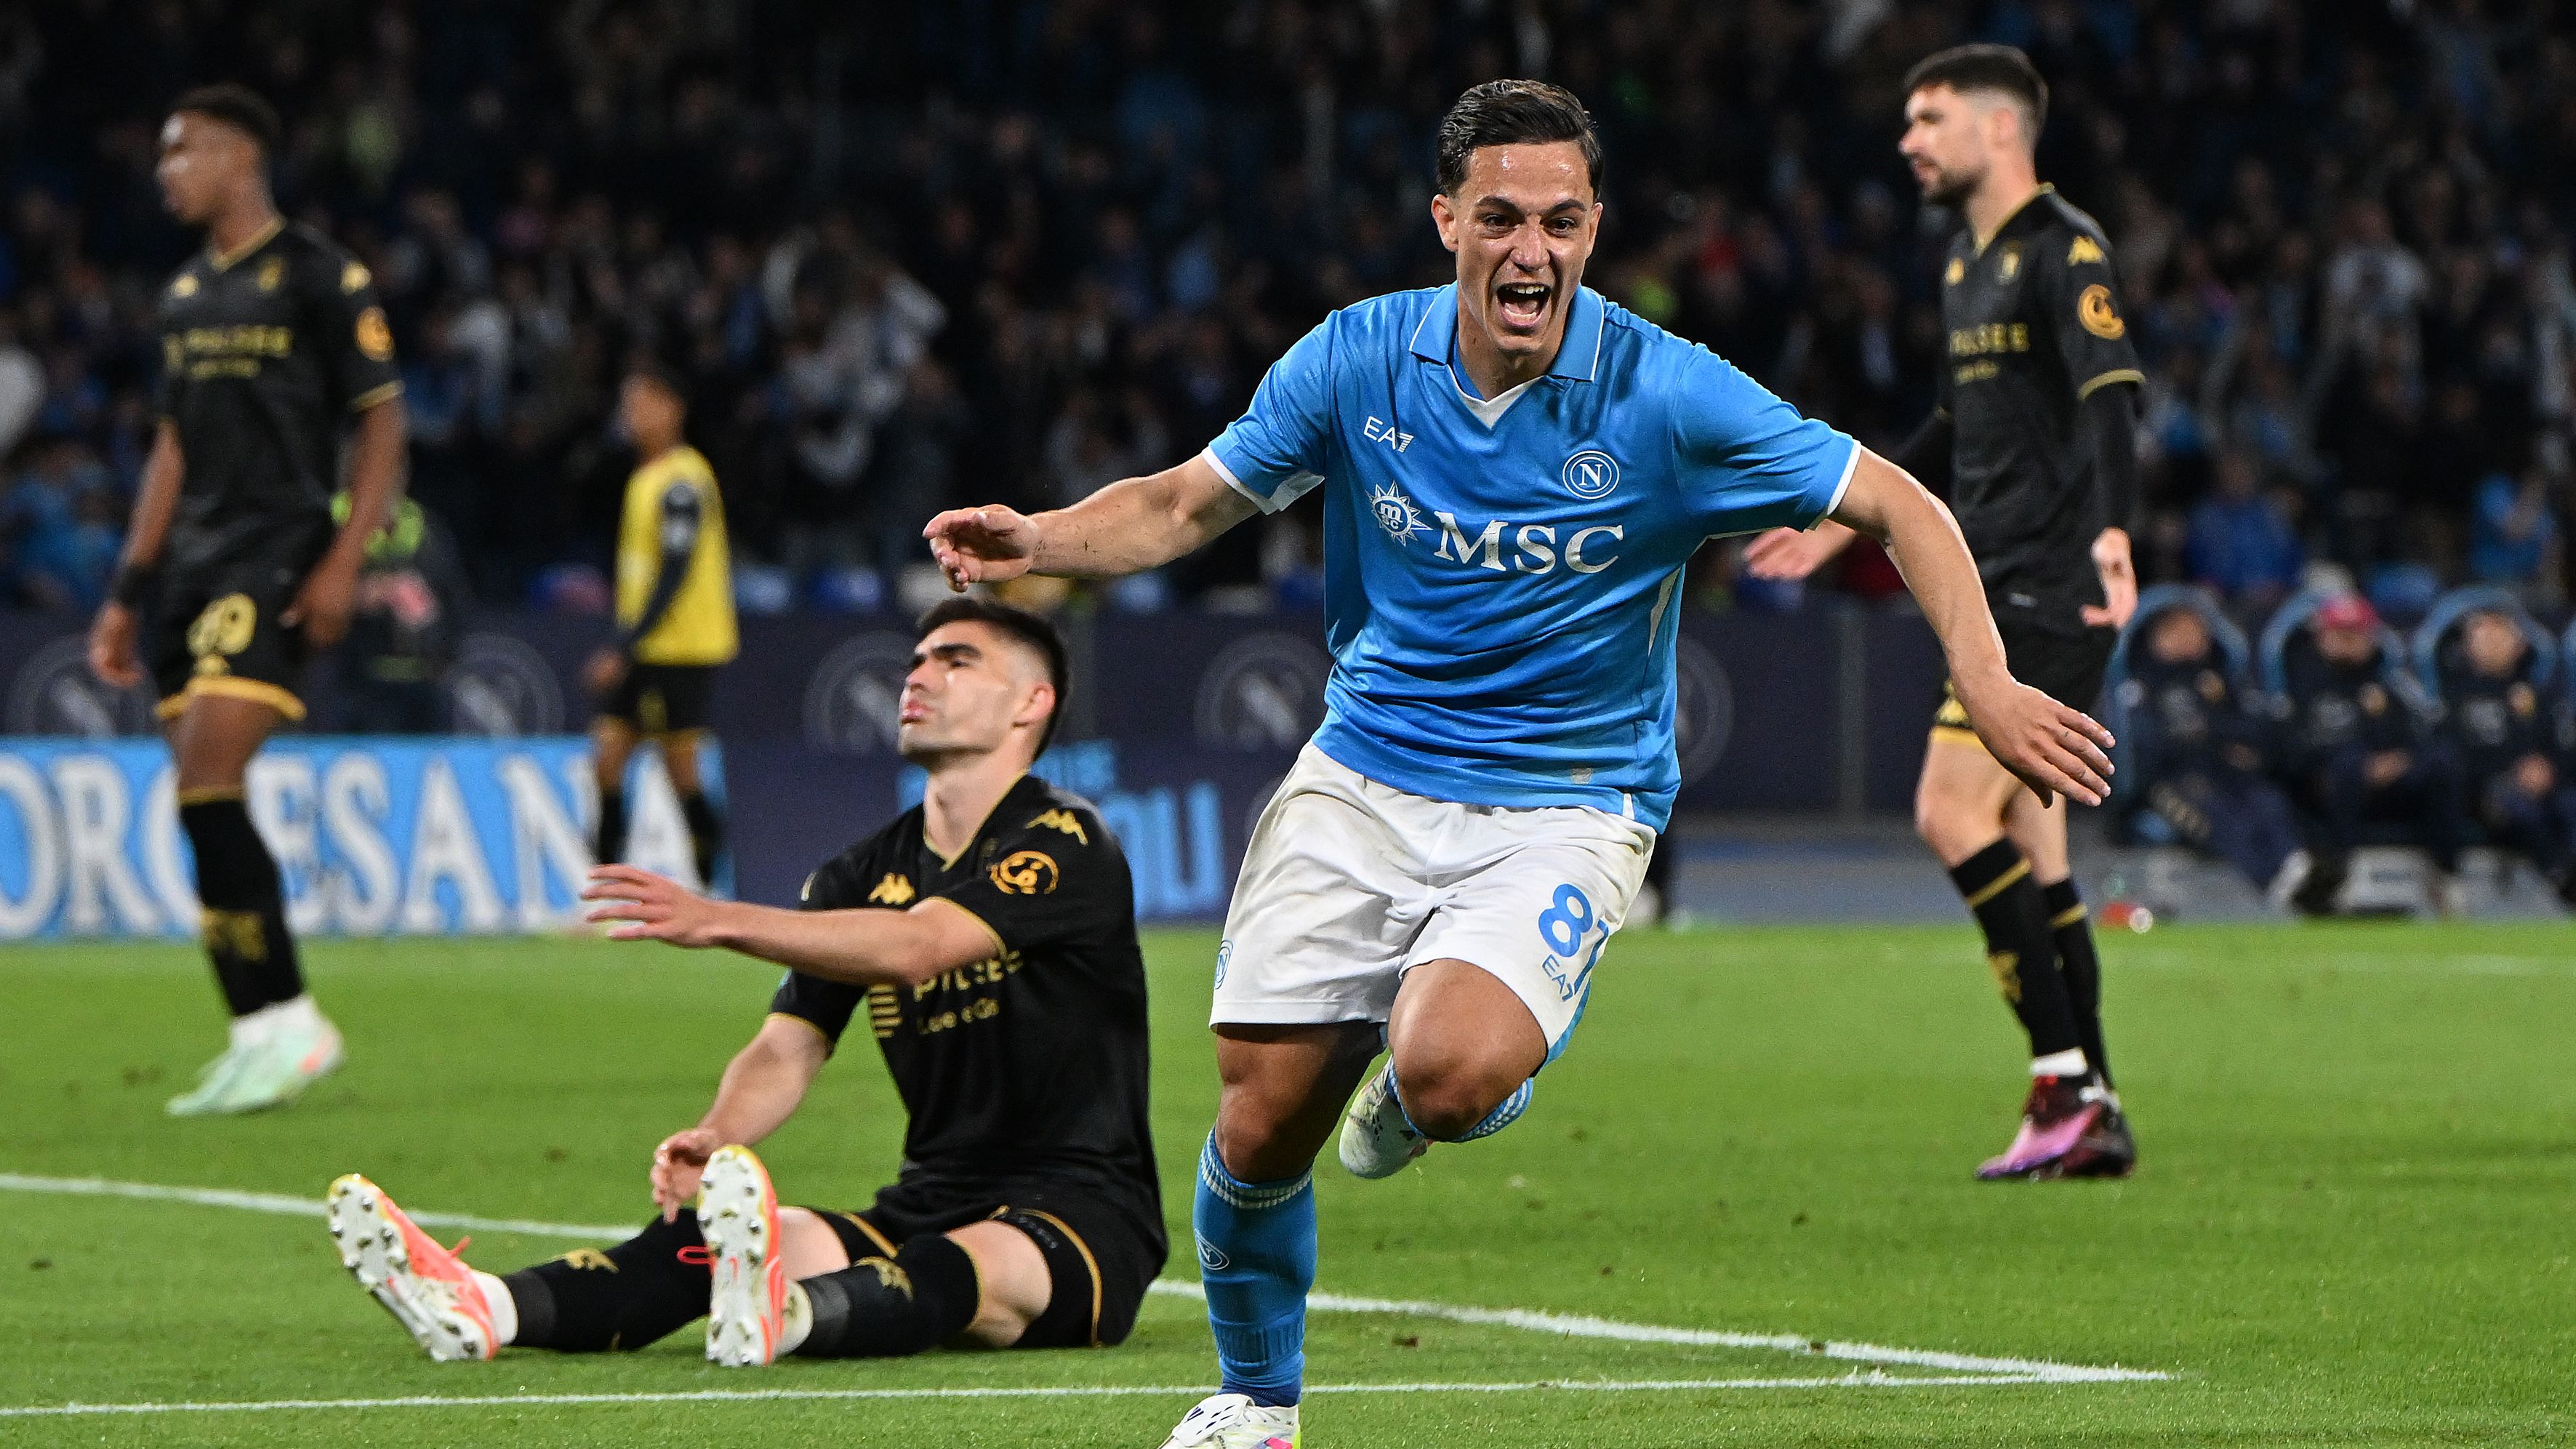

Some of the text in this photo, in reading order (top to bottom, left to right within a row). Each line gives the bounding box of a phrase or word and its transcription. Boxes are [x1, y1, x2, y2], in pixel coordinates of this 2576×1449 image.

[1363, 415, 1414, 453] EA7
[1579, 462, 1604, 487] N
[1433, 510, 1624, 574] MSC
[1541, 953, 1573, 1002] EA7
